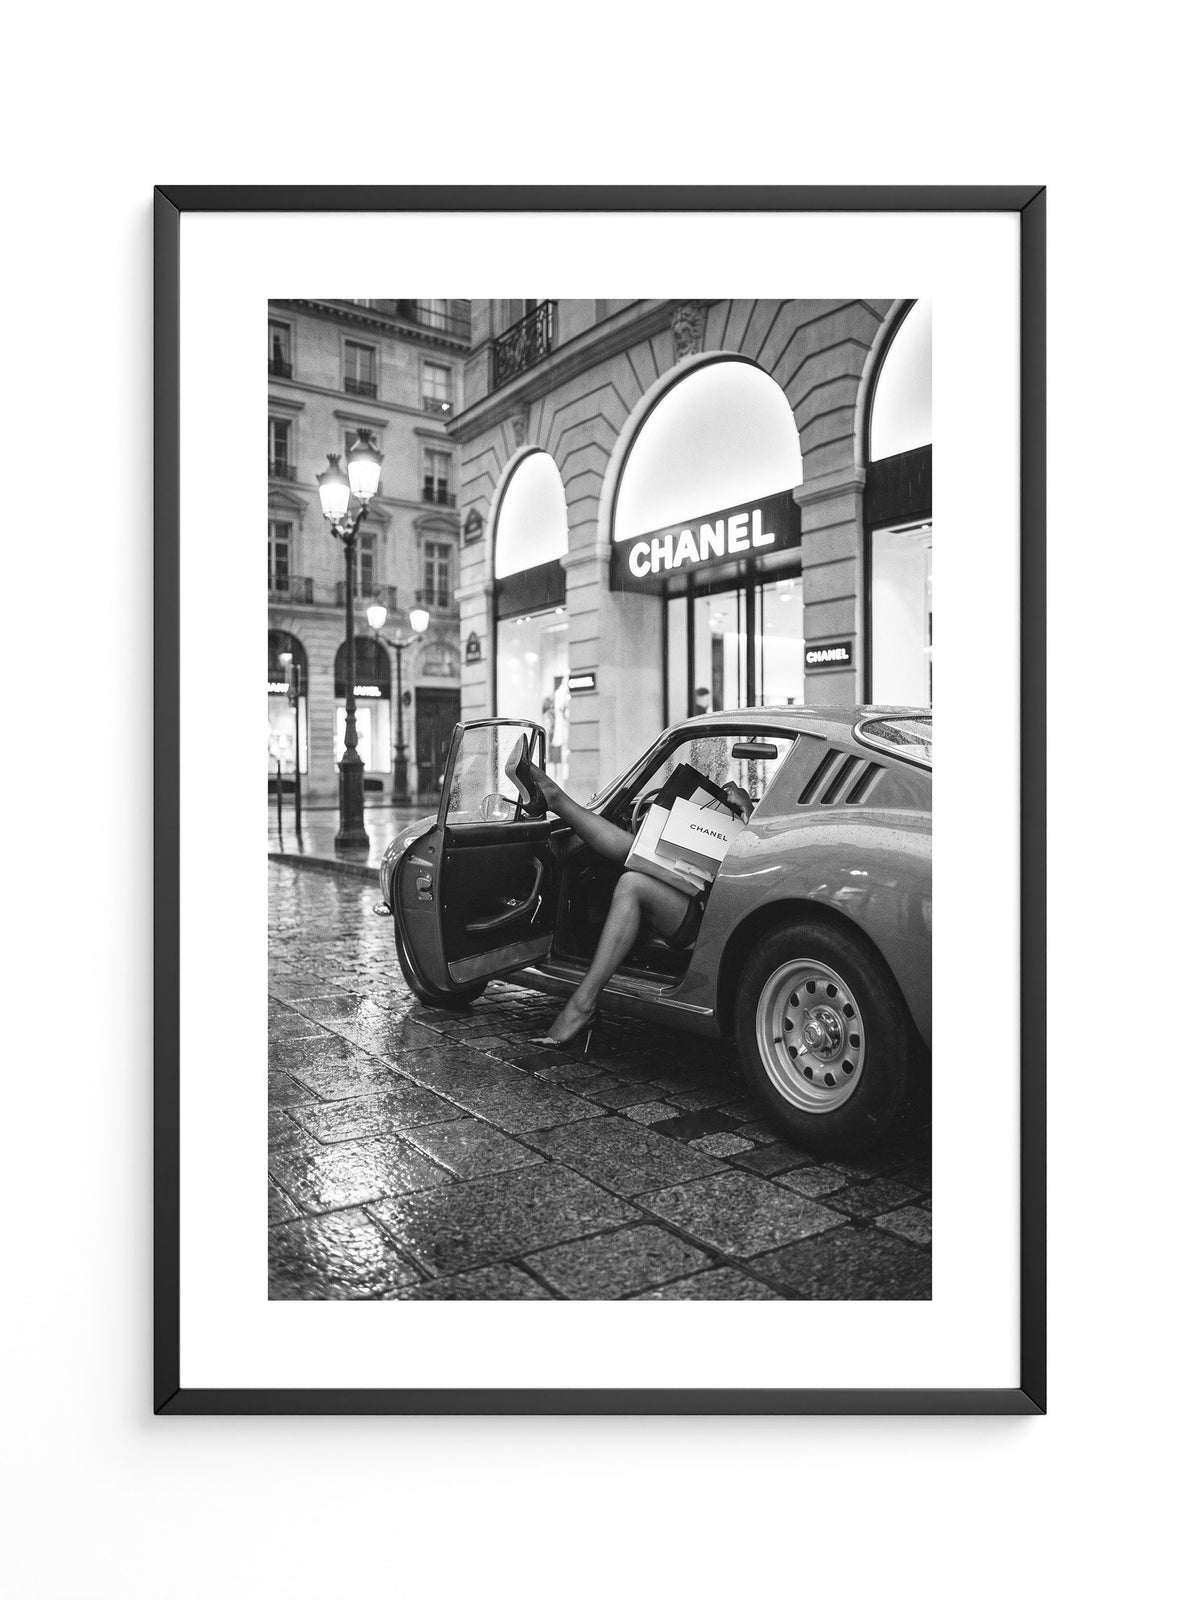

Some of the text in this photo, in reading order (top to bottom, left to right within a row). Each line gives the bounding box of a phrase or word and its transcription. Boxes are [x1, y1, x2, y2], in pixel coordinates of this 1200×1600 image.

[629, 509, 775, 577] CHANEL
[806, 648, 849, 663] CHANEL
[689, 823, 728, 842] CHANEL
